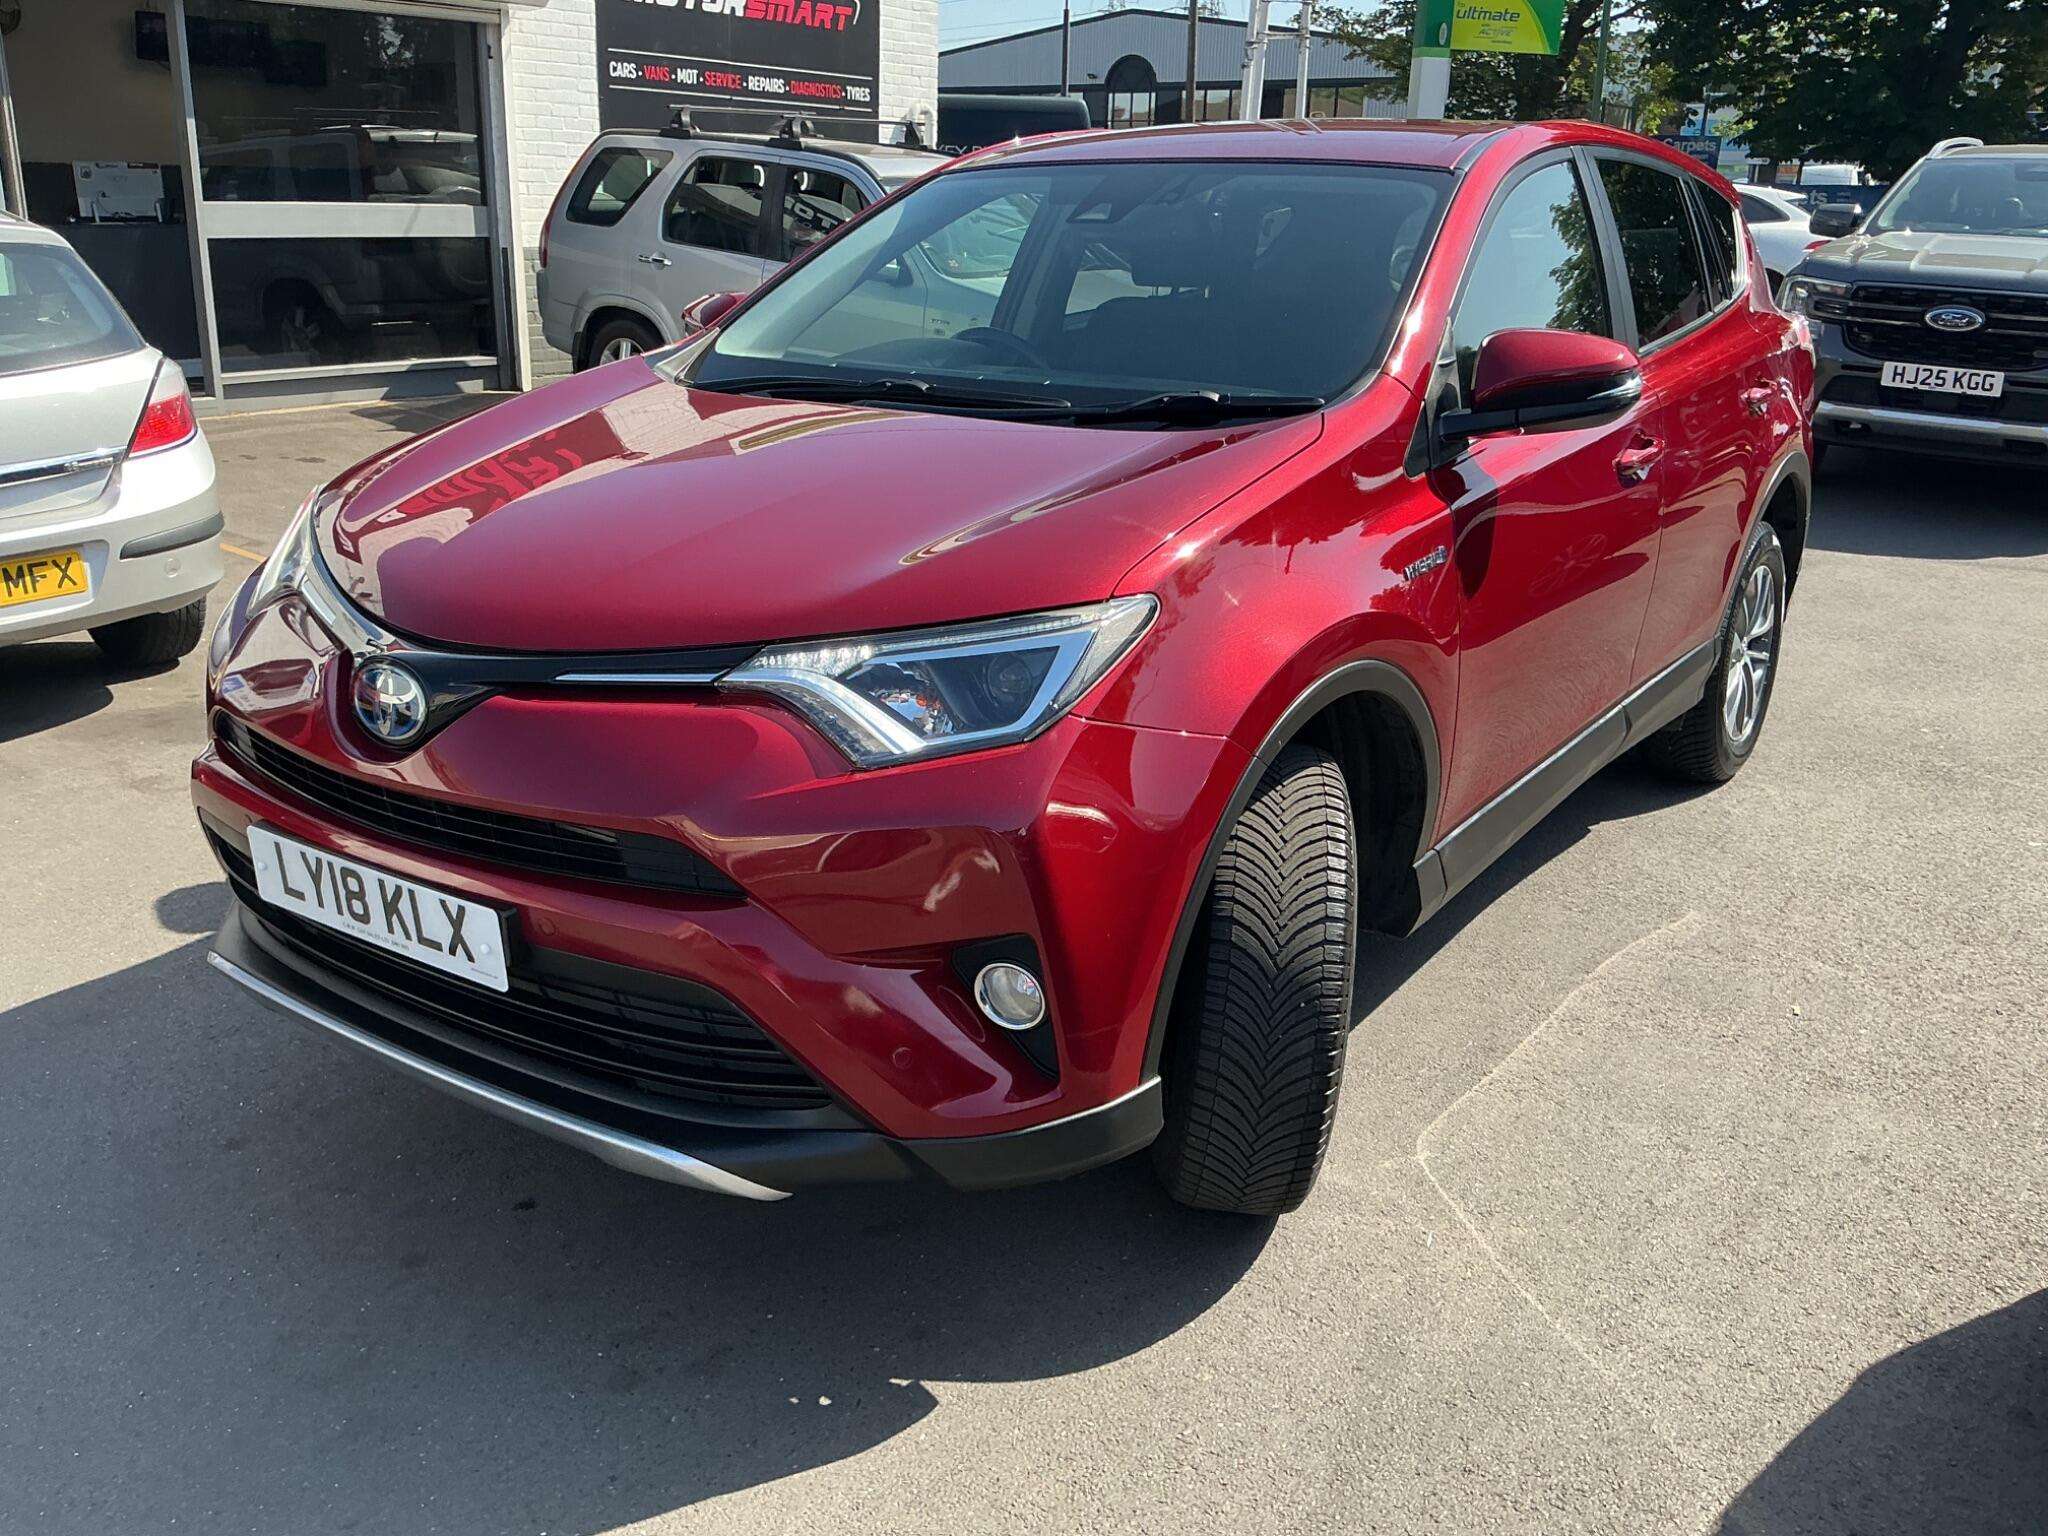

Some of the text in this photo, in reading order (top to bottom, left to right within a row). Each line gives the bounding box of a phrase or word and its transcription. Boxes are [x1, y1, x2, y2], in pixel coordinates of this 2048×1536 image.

[1456, 6, 1520, 22] ultimate
[609, 61, 871, 102] CARS VANS MOT SERVICE REPAIRS DIAGNOSTICS TYRES
[1892, 365, 1996, 392] HJ25 KGG
[1, 556, 78, 598] MFX
[274, 841, 476, 964] LY18 KLX
